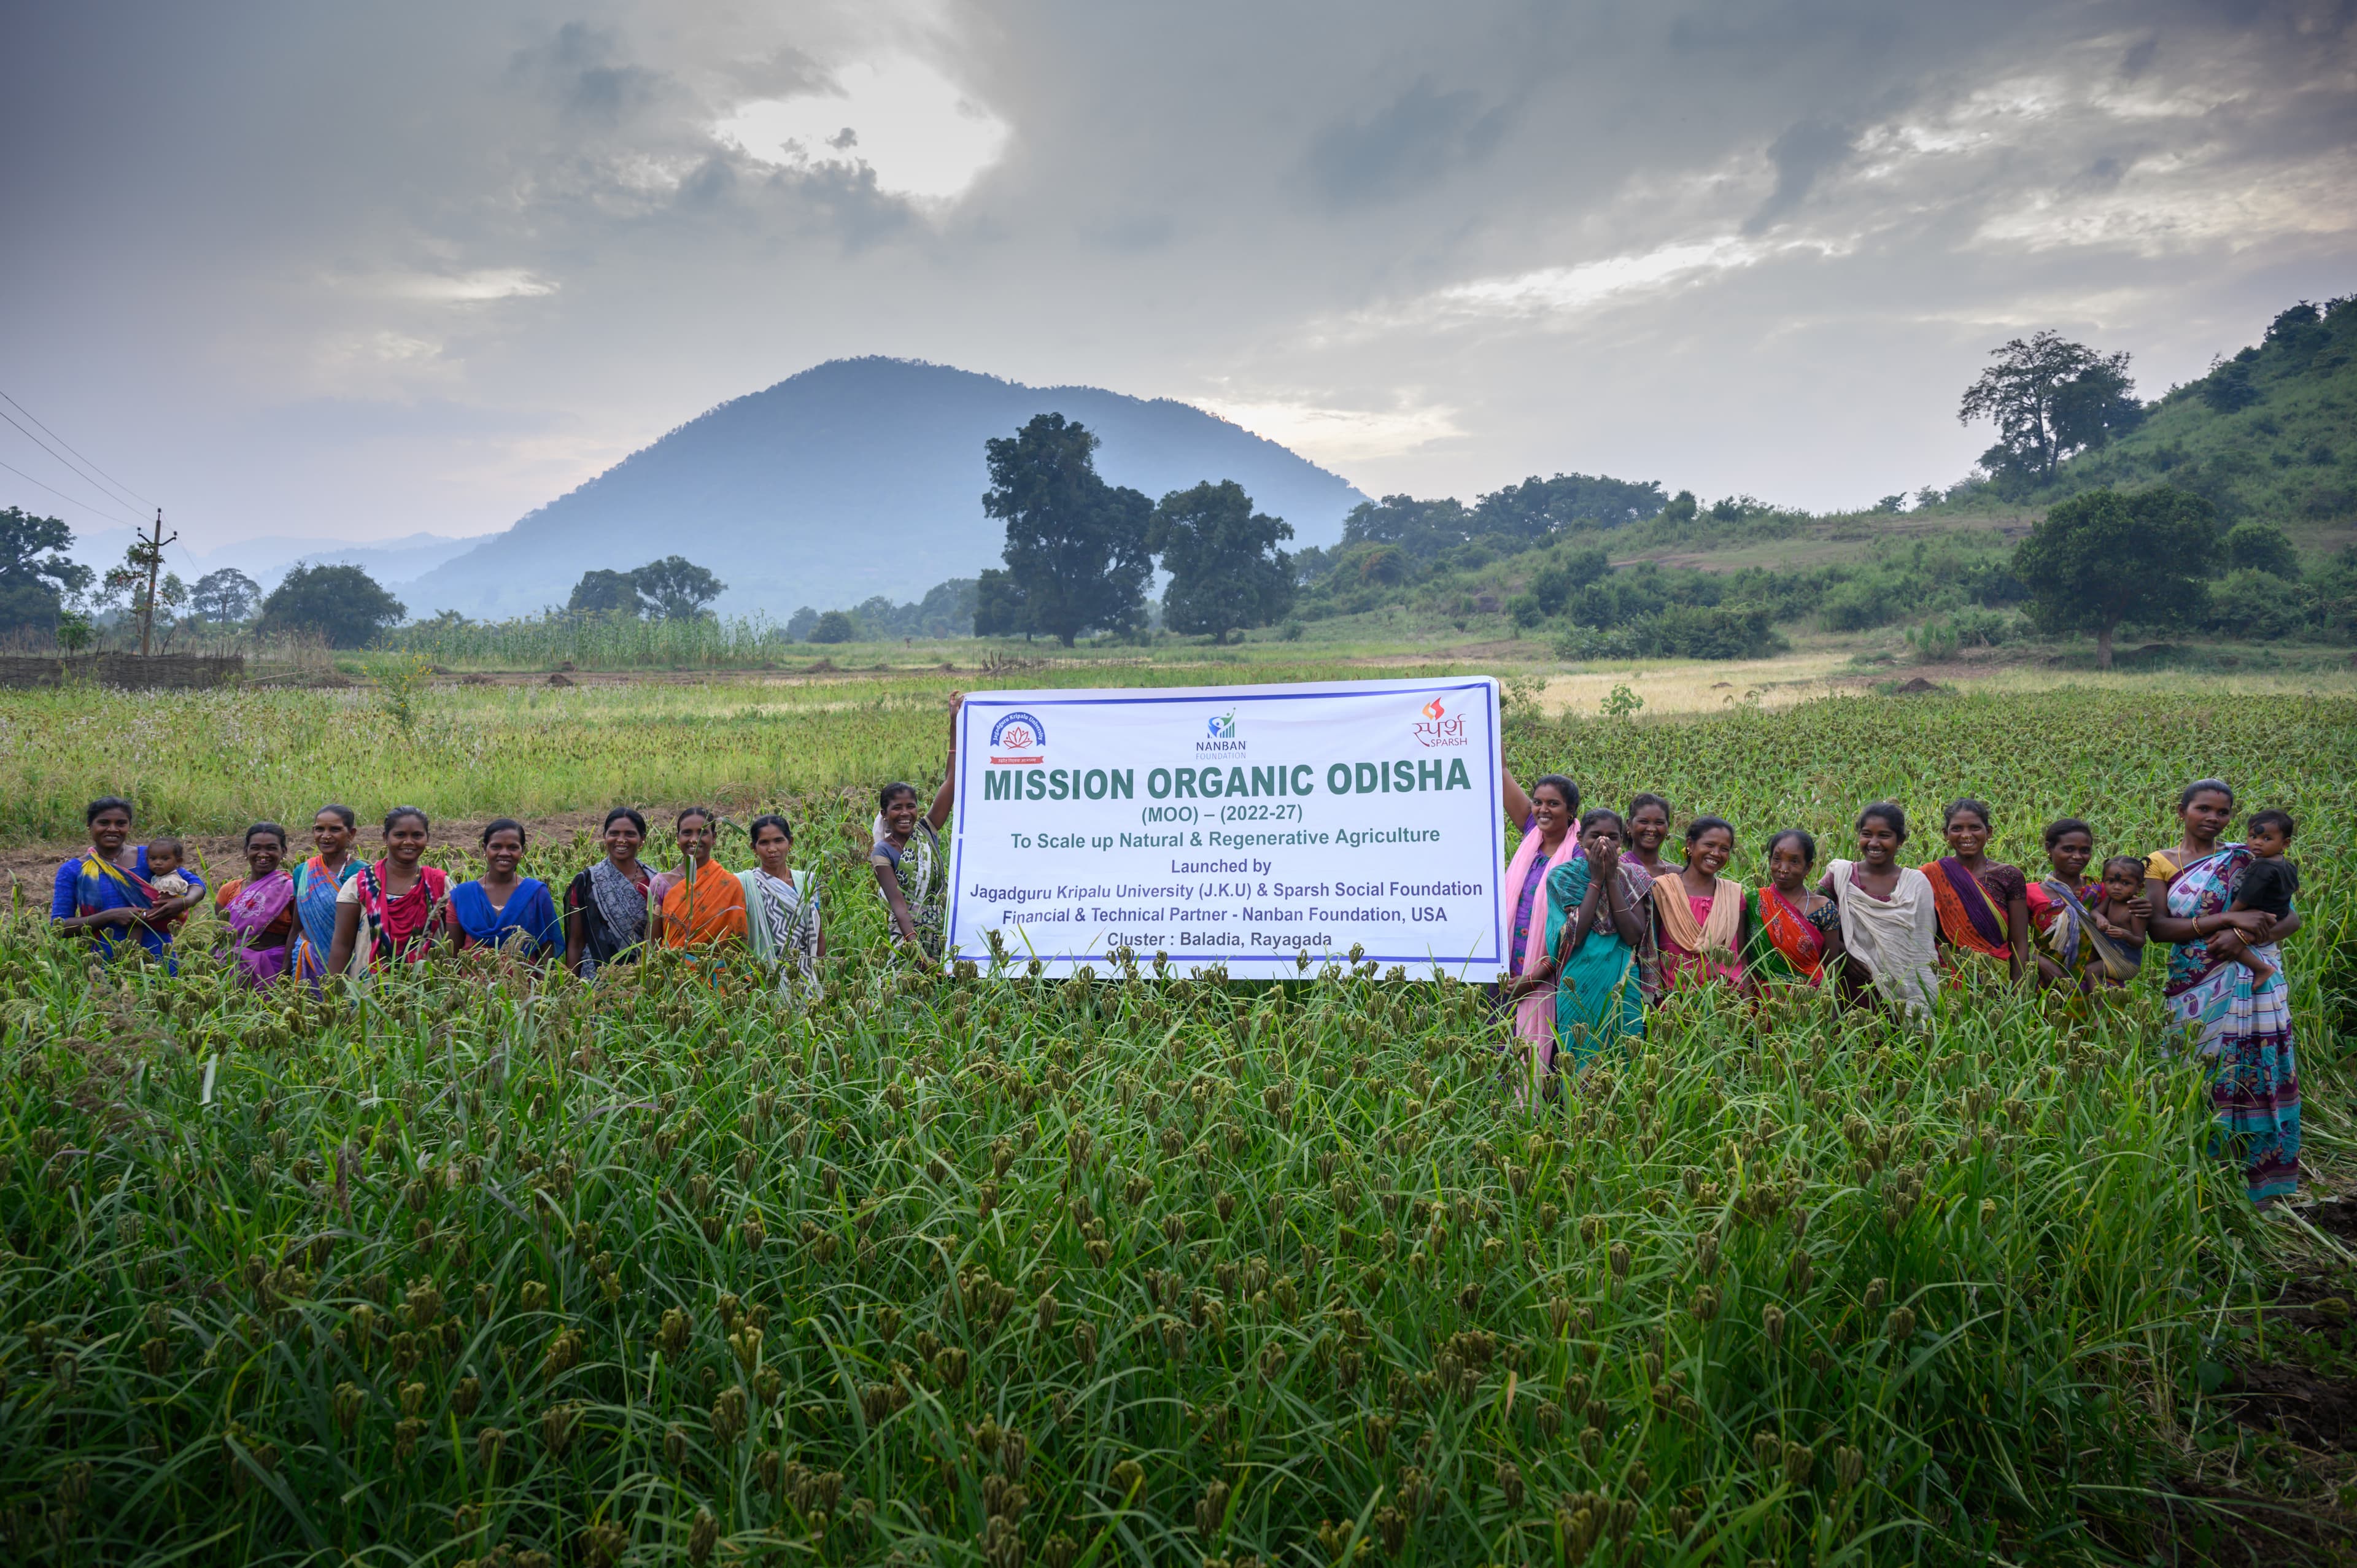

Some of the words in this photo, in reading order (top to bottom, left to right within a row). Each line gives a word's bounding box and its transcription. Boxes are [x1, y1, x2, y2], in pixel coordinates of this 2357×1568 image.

[993, 717, 1010, 741] Jagadguru
[1028, 716, 1044, 741] University
[1196, 741, 1247, 752] NANBAN
[1431, 737, 1468, 747] SPARSH
[1196, 752, 1247, 760] FOUNDATION
[984, 768, 1134, 801] MISSION
[1147, 765, 1314, 800] ORGANIC
[1326, 757, 1472, 795] ODISHA
[1142, 805, 1199, 827] (MOO)
[1220, 803, 1302, 825] (2022-27)
[1011, 833, 1032, 849] To
[1037, 832, 1086, 849] Scale
[1091, 836, 1113, 852] up
[1120, 832, 1183, 848] Natural
[1190, 831, 1203, 847] &
[1209, 828, 1329, 850] Regenerative
[1334, 827, 1441, 848] Agriculture
[1171, 858, 1248, 873] Launched
[1253, 858, 1272, 876] by
[970, 883, 1052, 905] Jagadguru
[1056, 884, 1111, 902] Kripalu
[1116, 882, 1194, 902] University
[1199, 882, 1252, 901] (J.K.U)
[1256, 882, 1268, 897] &
[1273, 882, 1329, 901] Sparsh
[1334, 881, 1384, 897] Social
[1390, 880, 1482, 897] Foundation
[1002, 908, 1070, 925] Financial
[1074, 907, 1086, 922] &
[1091, 906, 1164, 922] Technical
[1169, 906, 1228, 922] Partner
[1242, 906, 1303, 922] Nanban
[1309, 906, 1406, 925] Foundation,
[1411, 906, 1448, 922] USA
[1107, 931, 1166, 946] Cluster
[1180, 931, 1245, 949] Baladia,
[1250, 932, 1332, 949] Rayagada
